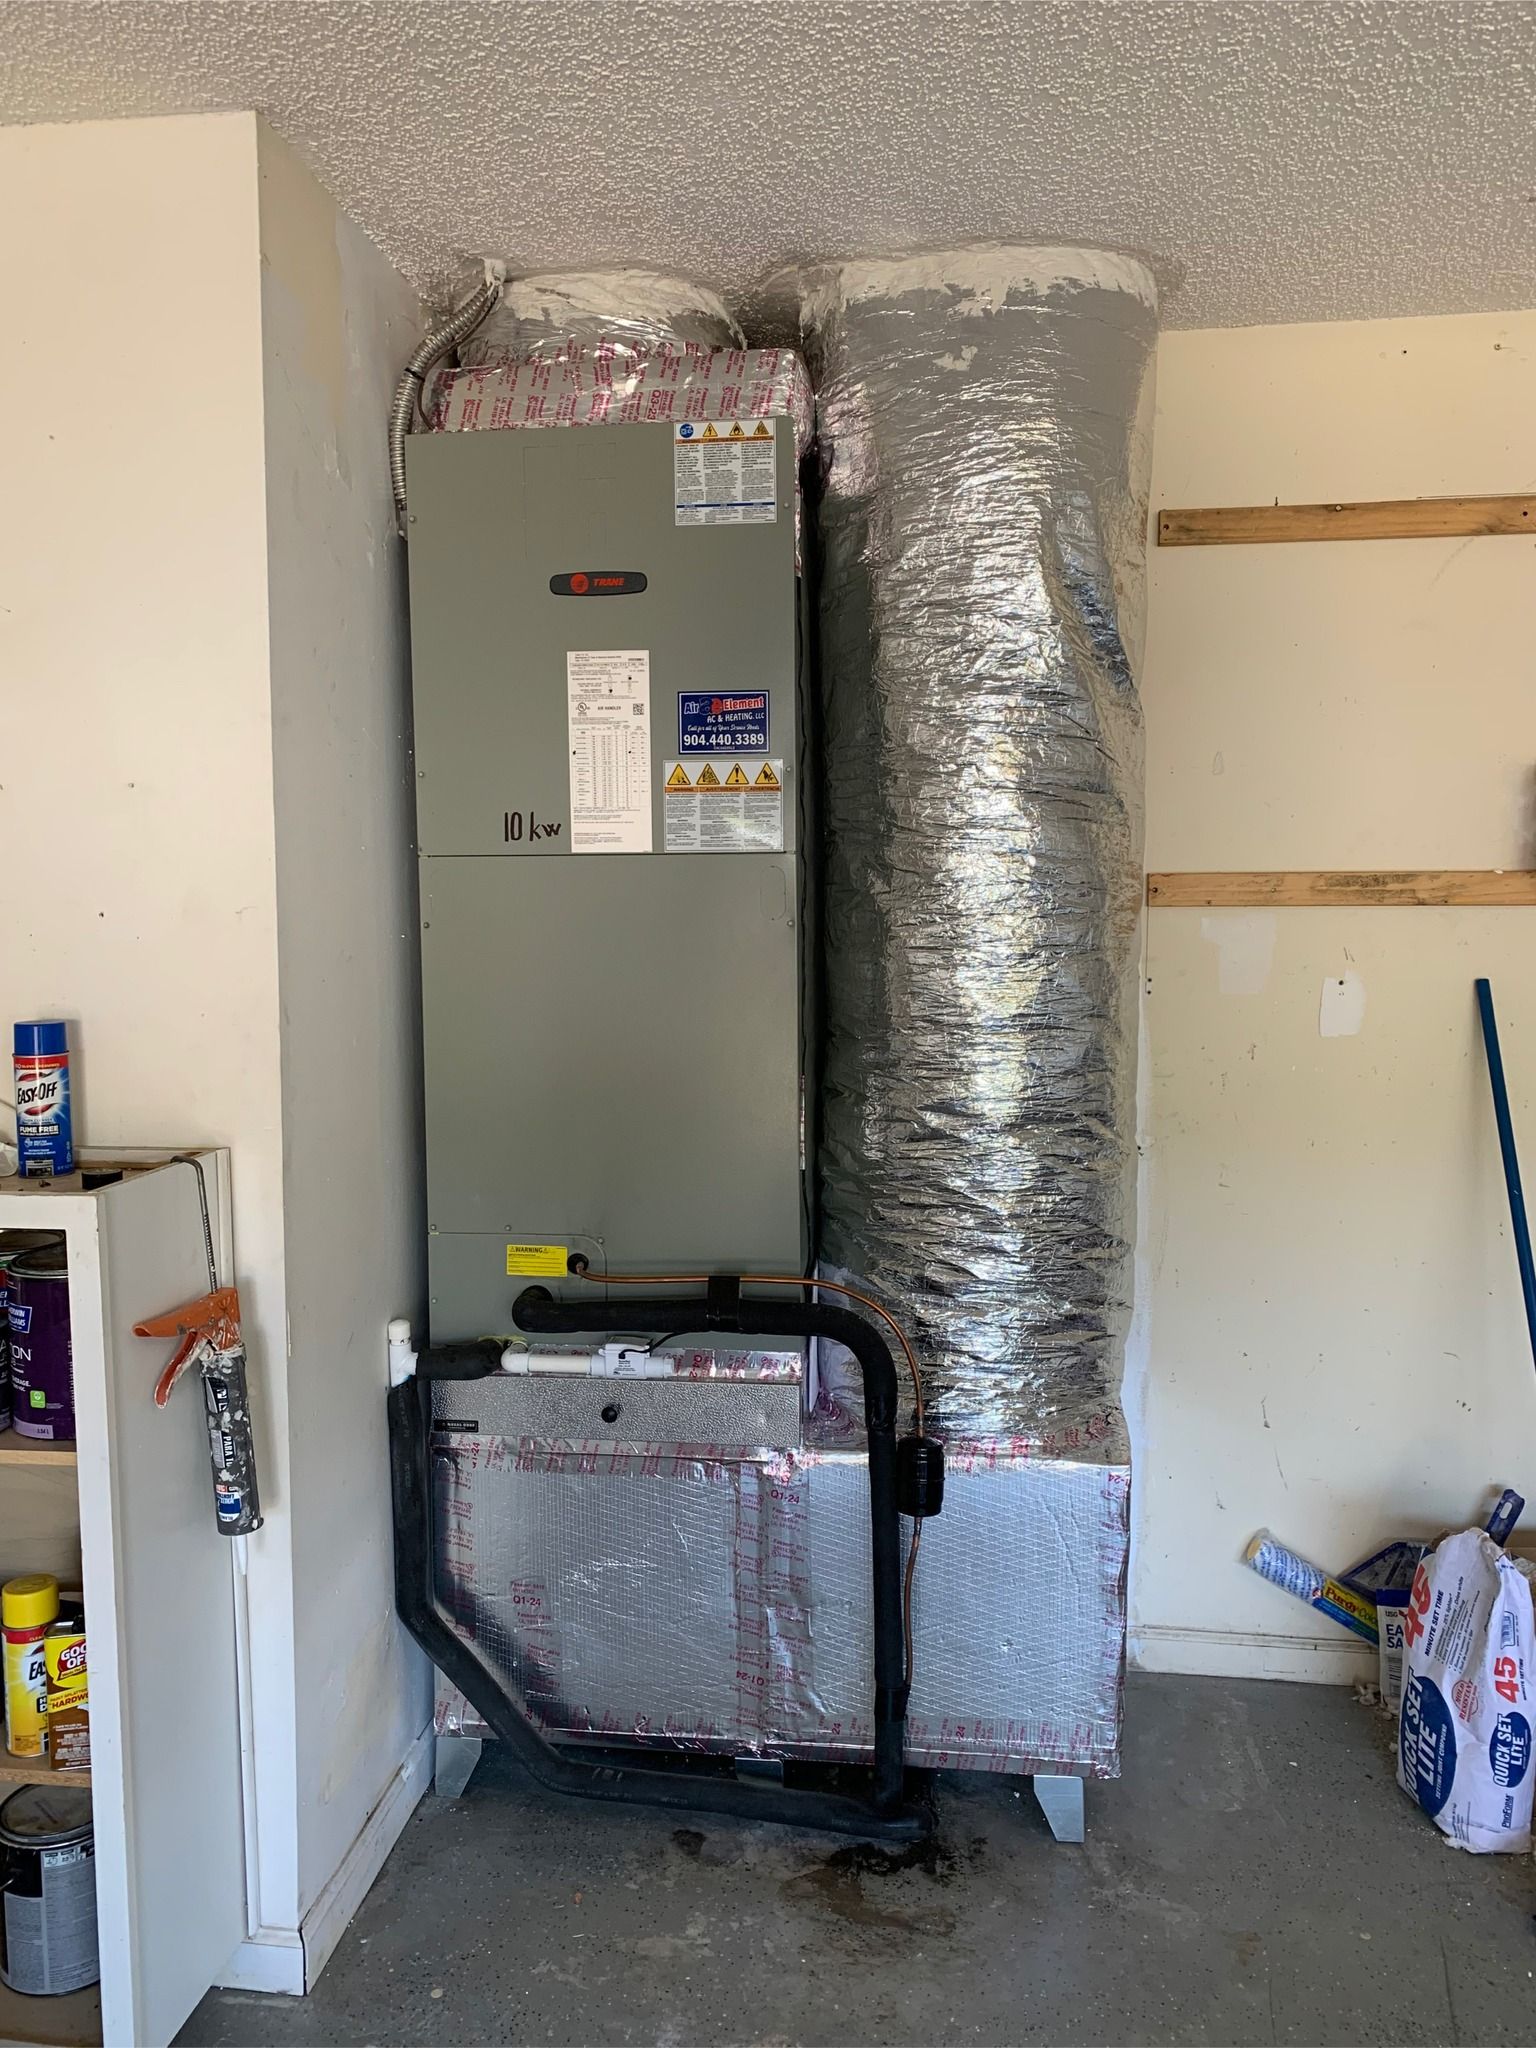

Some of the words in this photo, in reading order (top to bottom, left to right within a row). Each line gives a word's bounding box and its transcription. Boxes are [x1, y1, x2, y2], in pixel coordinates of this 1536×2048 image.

[647, 390, 661, 420] Q3-23
[592, 578, 625, 586] TRANE
[684, 701, 699, 714] Air
[723, 696, 764, 711] Element
[684, 734, 764, 746] 904.440.3389
[505, 812, 522, 842] 10
[18, 1081, 57, 1105] EASY-OFF
[689, 1354, 703, 1377] Q4-2
[223, 1436, 233, 1457] PARA
[770, 1490, 800, 1504] Q1-24
[514, 1595, 541, 1607] Q1-24
[1326, 1587, 1358, 1613] Purdy
[1359, 1608, 1378, 1625] Colo
[1404, 1563, 1430, 1648] 45
[1435, 1589, 1444, 1609] TIME
[1432, 1610, 1440, 1626] SET
[1386, 1624, 1404, 1636] EA
[1424, 1626, 1436, 1657] MINUTE
[61, 1643, 86, 1660] GOO
[1387, 1637, 1404, 1649] SA
[67, 1655, 86, 1668] OF
[736, 1670, 764, 1686] Q1-24
[1494, 1656, 1520, 1703] 45
[1407, 1666, 1424, 1723] SET
[1459, 1680, 1473, 1720] RESISTANT
[1498, 1714, 1511, 1743] SET
[1418, 1722, 1437, 1785] LITE
[1511, 1736, 1525, 1765] LITE
[1493, 1744, 1511, 1787] QUICK
